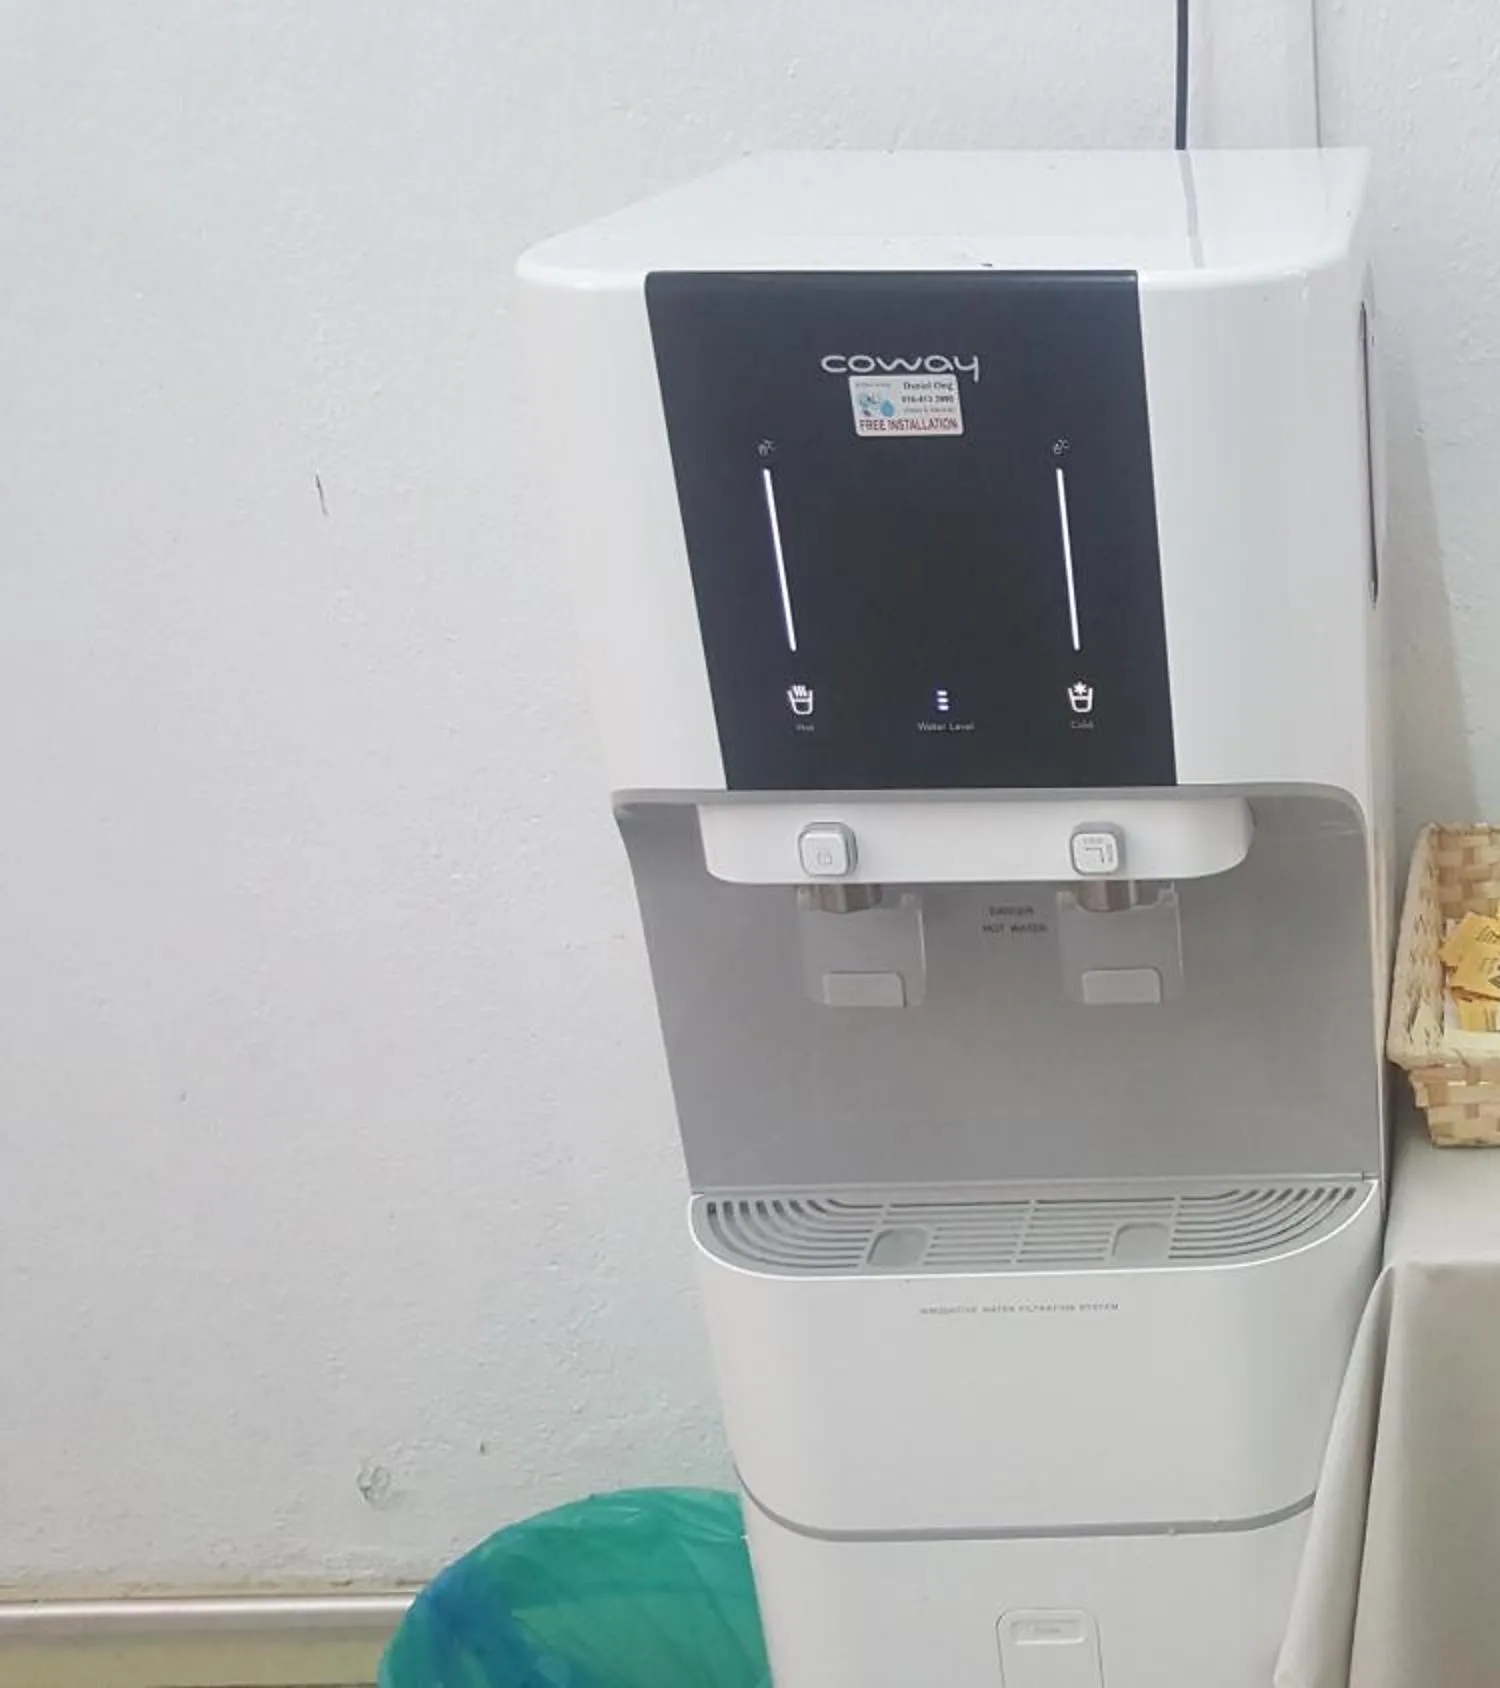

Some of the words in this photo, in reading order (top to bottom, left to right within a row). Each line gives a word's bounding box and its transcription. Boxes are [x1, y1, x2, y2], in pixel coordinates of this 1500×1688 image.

[821, 355, 979, 383] coway
[860, 419, 887, 430] FREE
[888, 417, 958, 430] INSTALLATION
[917, 720, 946, 731] Water
[949, 720, 975, 731] Level
